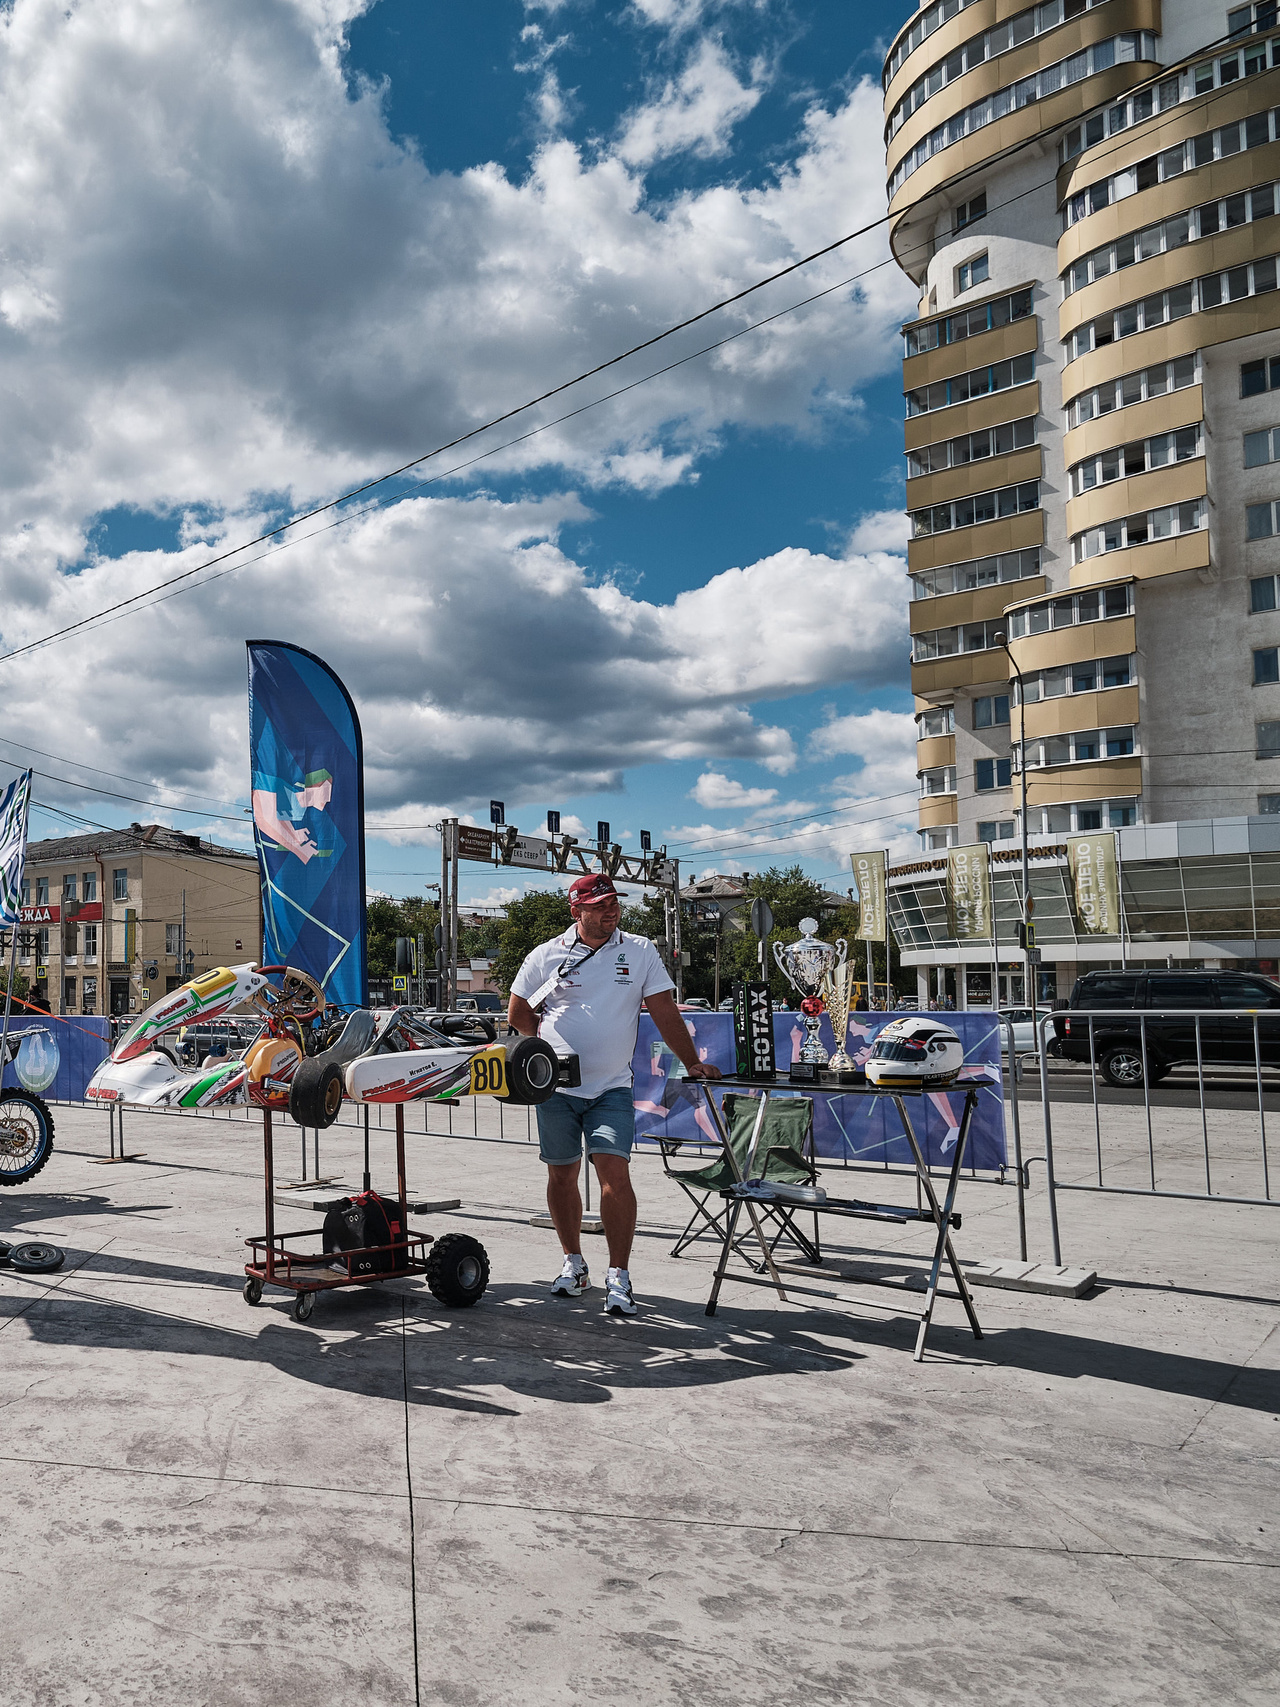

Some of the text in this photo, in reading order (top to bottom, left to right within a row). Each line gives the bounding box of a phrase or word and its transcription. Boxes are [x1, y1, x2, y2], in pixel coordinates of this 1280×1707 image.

[524, 850, 539, 860] СЕВЕР
[20, 907, 51, 922] ЕЖДА
[750, 990, 771, 1072] ROTAX
[409, 1063, 431, 1077] Игнатов
[473, 1056, 503, 1092] 80
